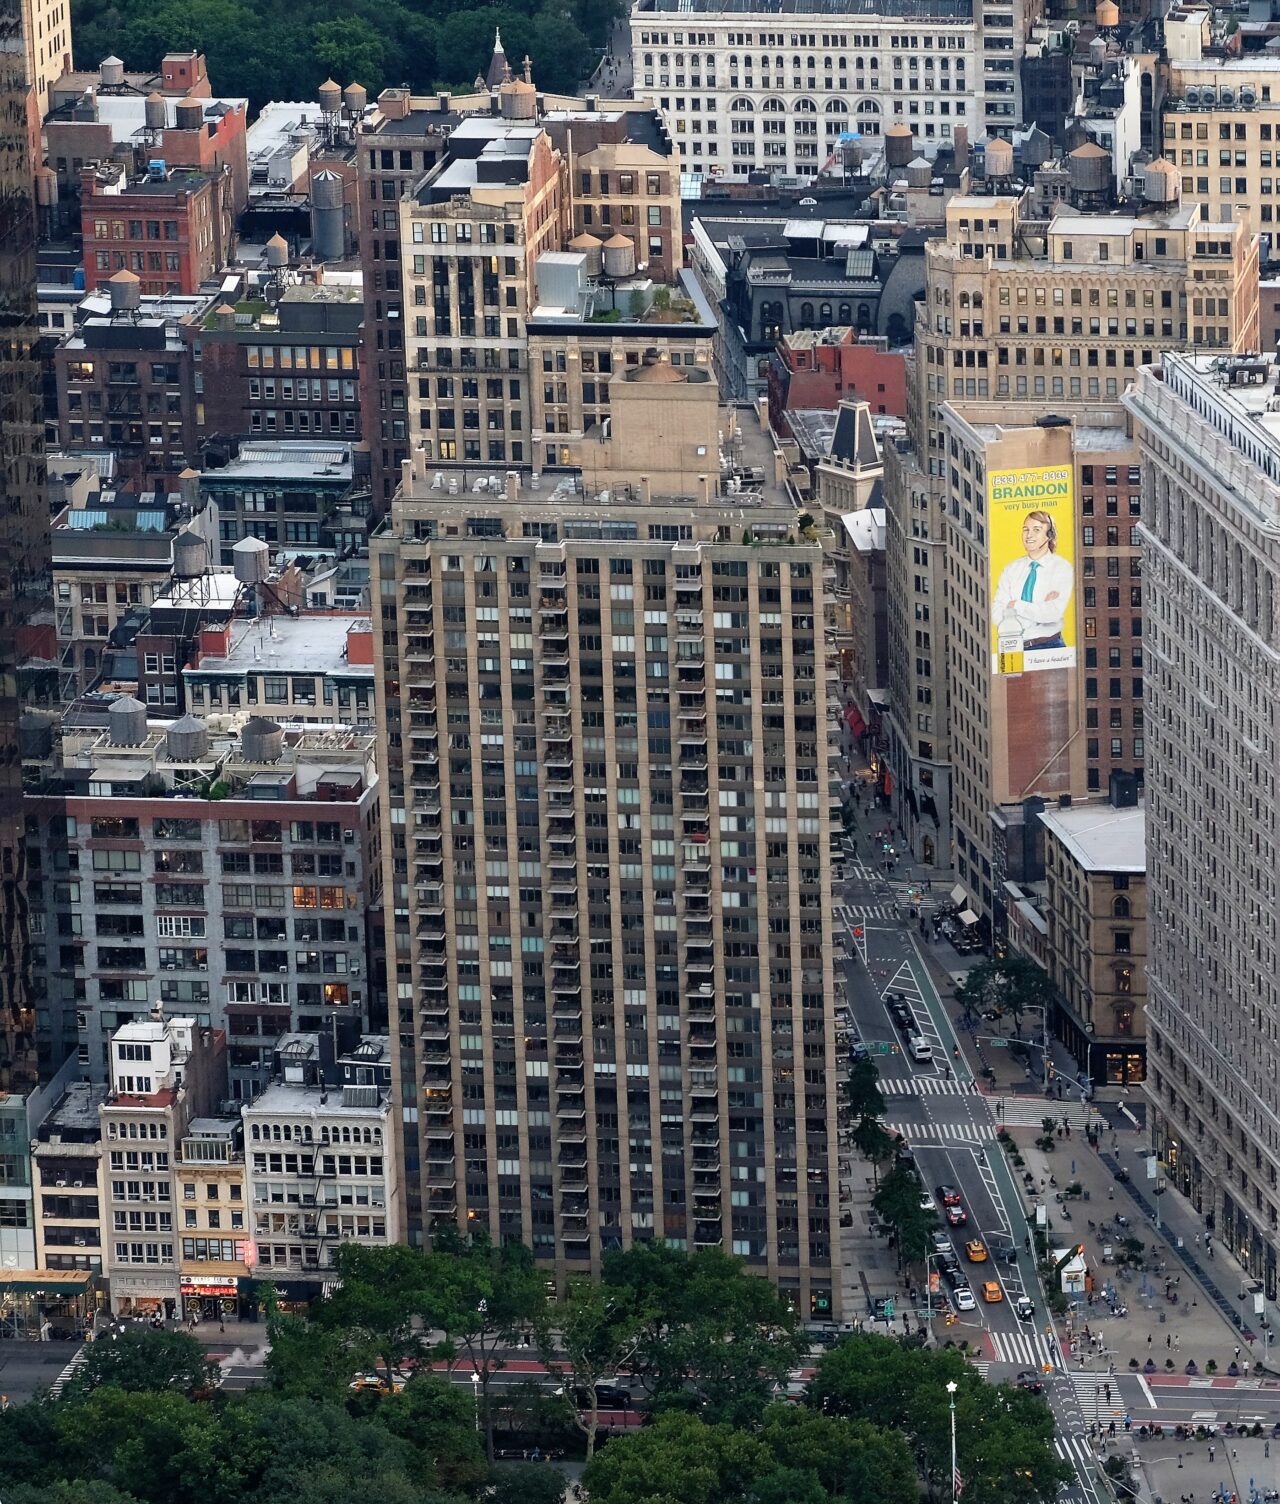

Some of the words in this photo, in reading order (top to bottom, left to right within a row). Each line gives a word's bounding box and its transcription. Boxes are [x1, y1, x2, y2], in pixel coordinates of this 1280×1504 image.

[992, 475, 1017, 487] (833)
[993, 482, 1068, 500] BRANDON
[1004, 503, 1020, 511] very
[1022, 501, 1040, 509] busy
[816, 1299, 828, 1307] TD
